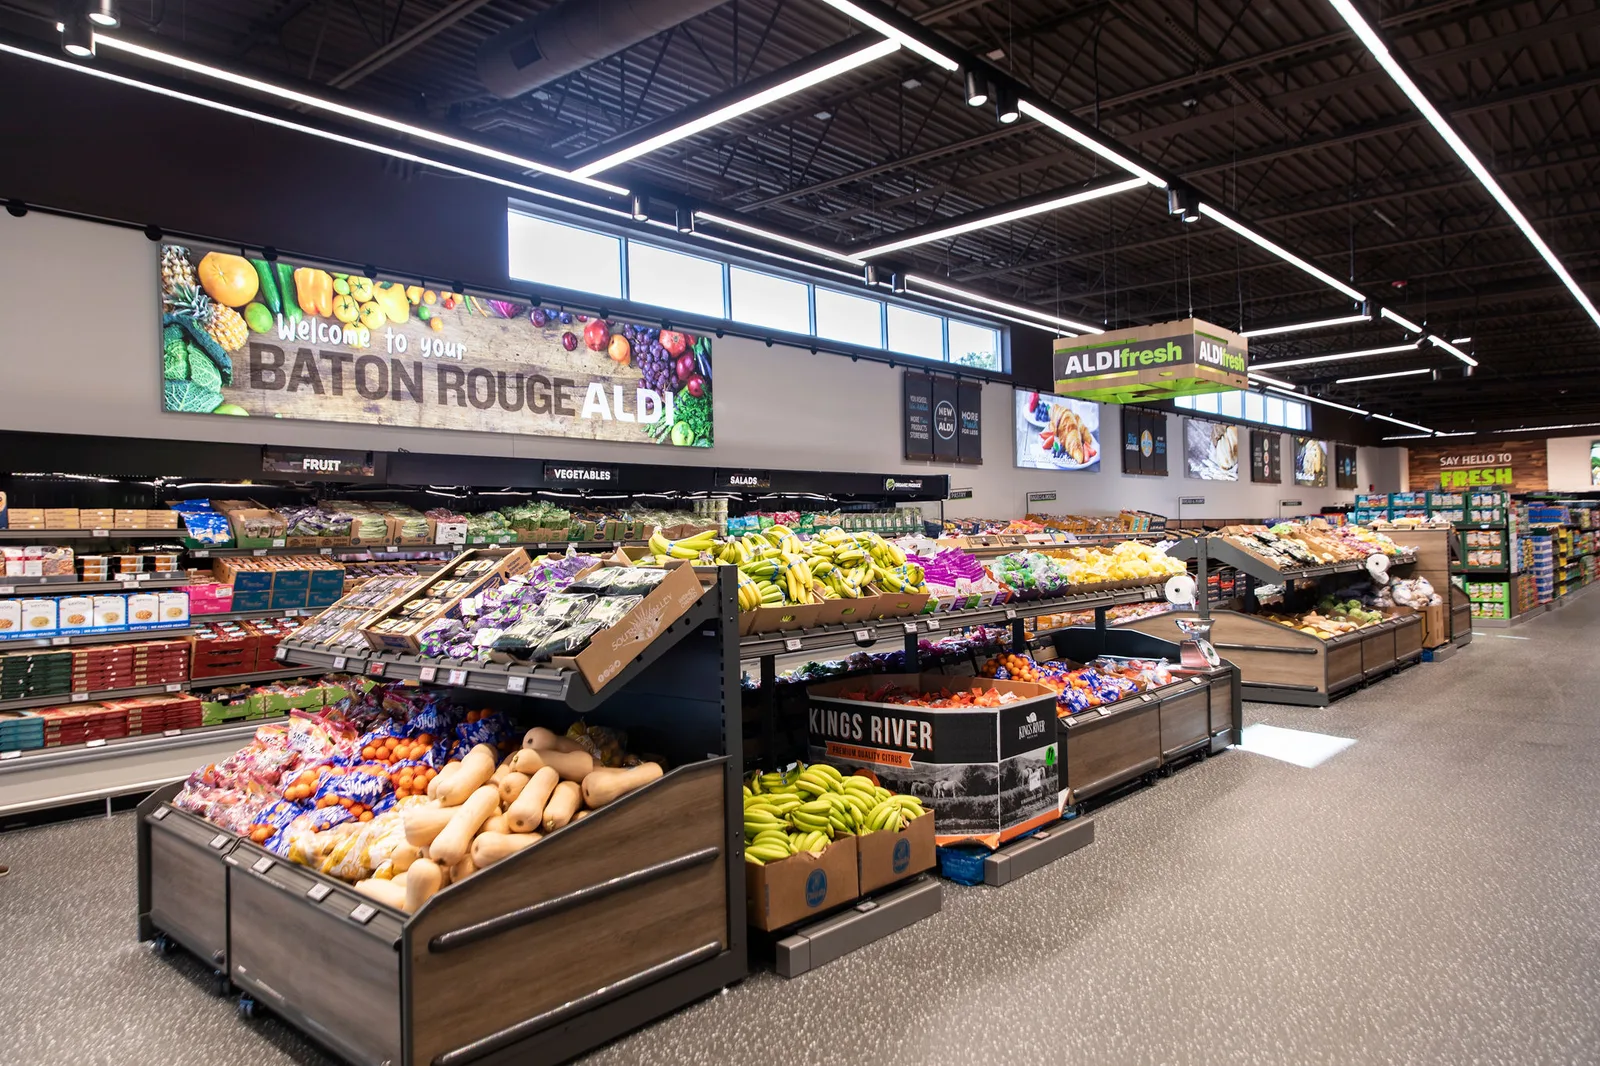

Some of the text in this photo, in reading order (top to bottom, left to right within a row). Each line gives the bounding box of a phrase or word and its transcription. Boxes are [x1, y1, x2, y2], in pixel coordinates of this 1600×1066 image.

[276, 312, 468, 361] Welcome to your
[1065, 341, 1182, 376] ALDIfresh
[1199, 340, 1245, 373] ALDIfresh
[249, 342, 675, 427] BATON ROUGE ALDI
[938, 406, 953, 417] NEW
[961, 410, 979, 421] MORE
[938, 421, 954, 432] ALDI
[302, 457, 341, 472] FRUIT
[1439, 452, 1512, 466] SAY HELLO TO
[554, 468, 611, 481] VEGETABLES
[729, 475, 758, 485] SALADS
[1440, 467, 1513, 488] FRESH
[808, 707, 934, 751] KINGS RIVER
[1018, 720, 1046, 740] KINGS RIVER
[832, 746, 903, 764] PREMIUM QUALITY CITRUS
